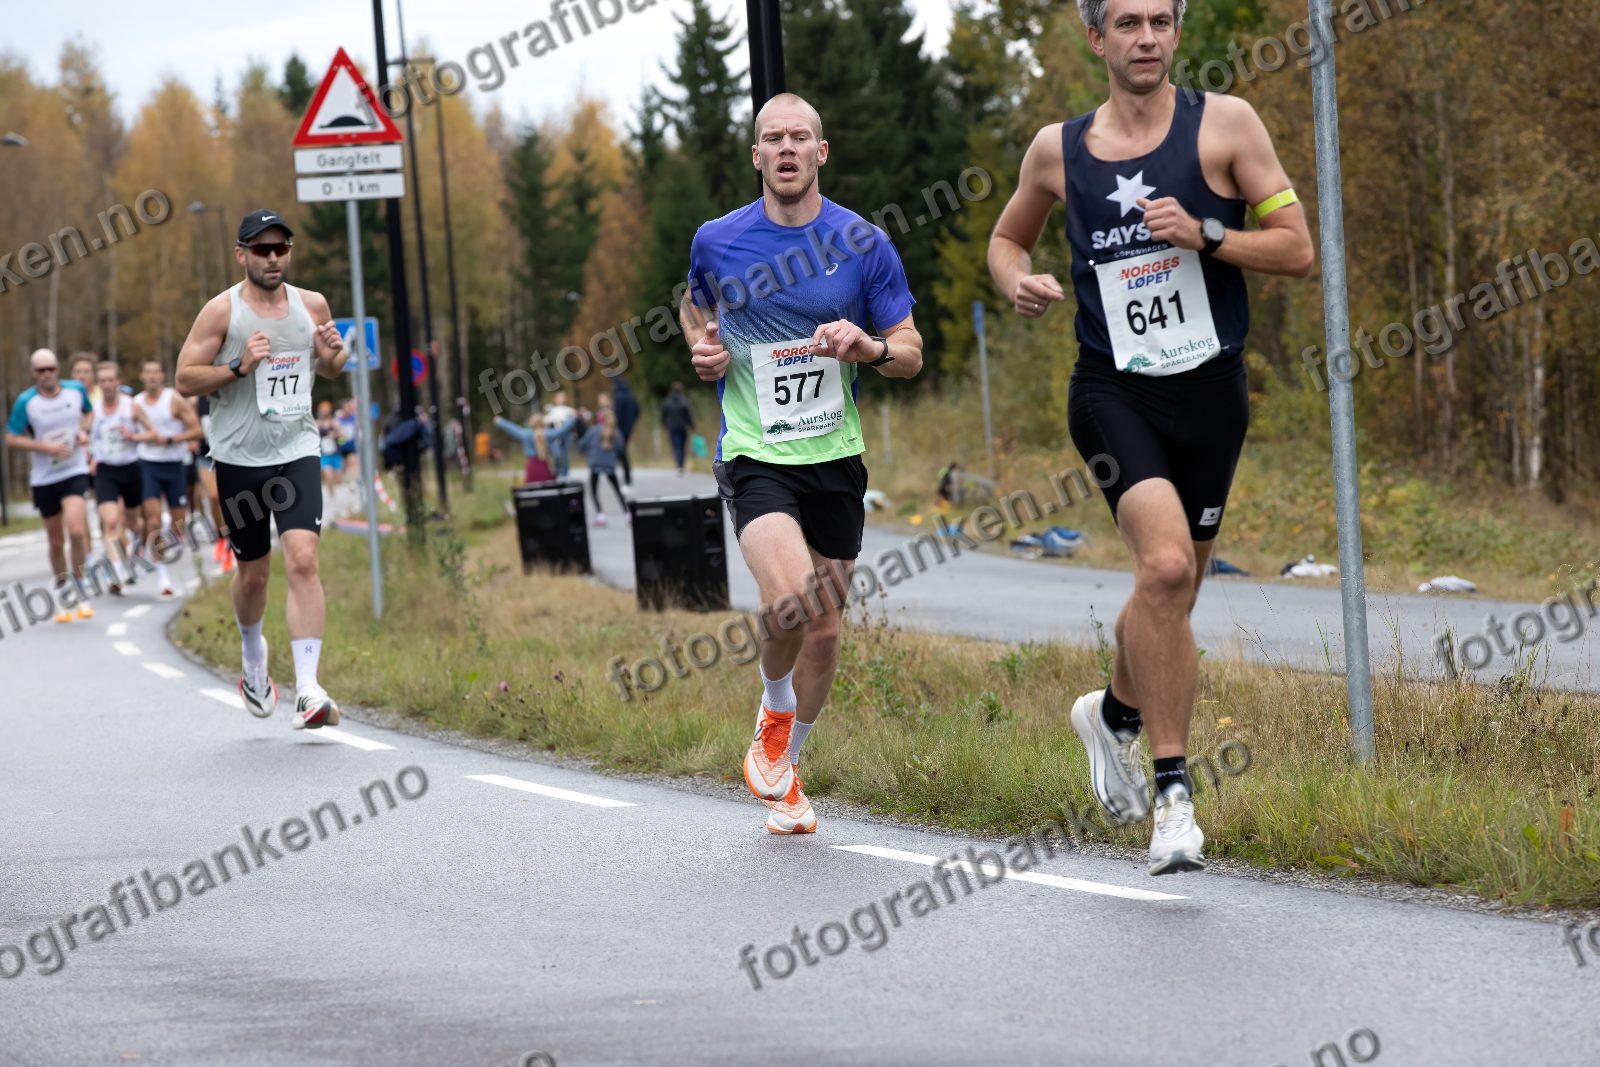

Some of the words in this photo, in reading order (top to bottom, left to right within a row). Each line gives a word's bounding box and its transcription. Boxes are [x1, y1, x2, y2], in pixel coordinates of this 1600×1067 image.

[317, 152, 381, 168] Gangfelt
[322, 182, 332, 196] 0
[348, 182, 354, 194] 1
[358, 182, 380, 194] km
[1091, 222, 1152, 249] SAYS
[1114, 243, 1168, 259] COPENHAGEN
[1120, 256, 1180, 280] NORGES
[1127, 270, 1172, 290] LØPET
[1126, 290, 1185, 335] 641
[1160, 338, 1215, 361] Aurskog
[267, 356, 301, 364] NORGES
[272, 363, 295, 371] LØPET
[776, 354, 815, 367] LØPET
[1161, 352, 1207, 369] SPAREBANK
[268, 375, 299, 397] 717
[774, 369, 825, 405] 577
[798, 410, 842, 425] Aurskog
